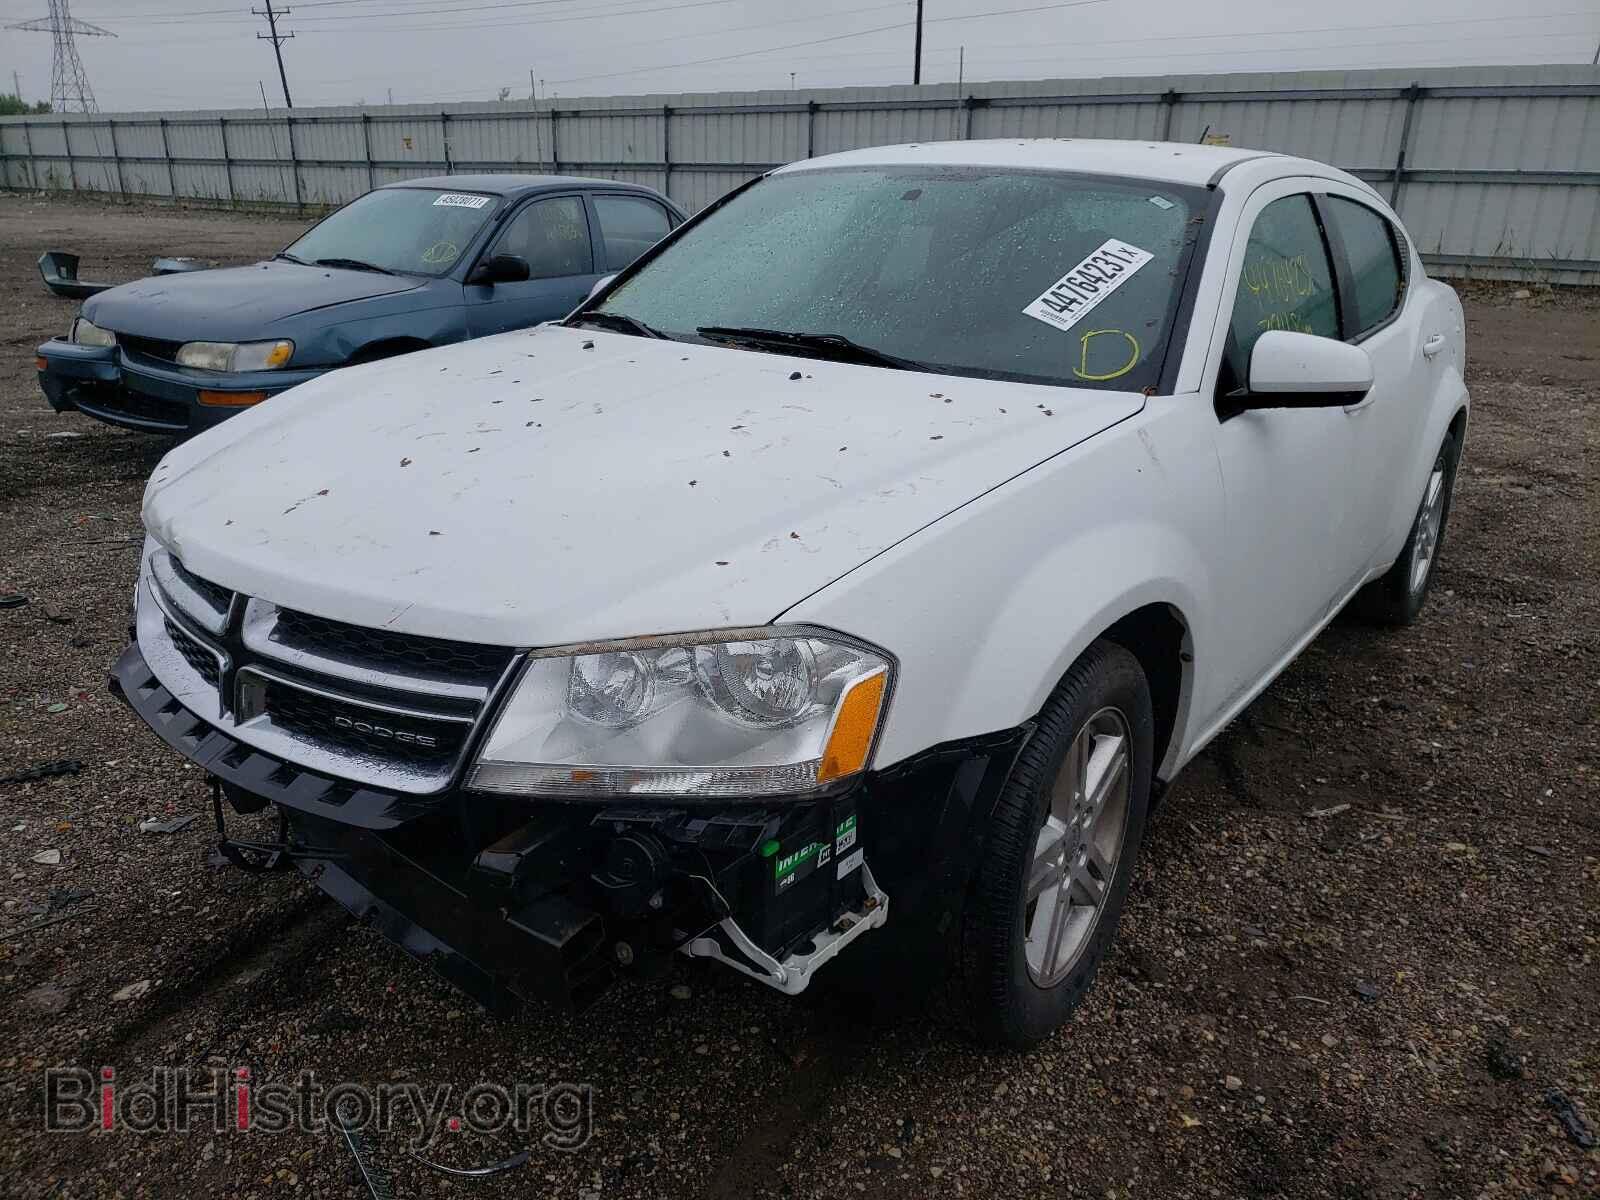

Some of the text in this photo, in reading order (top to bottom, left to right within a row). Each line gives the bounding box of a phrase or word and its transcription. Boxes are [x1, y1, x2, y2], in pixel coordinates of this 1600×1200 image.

[1041, 250, 1132, 313] 44764231
[1072, 329, 1140, 380] D
[334, 715, 437, 748] DODGE
